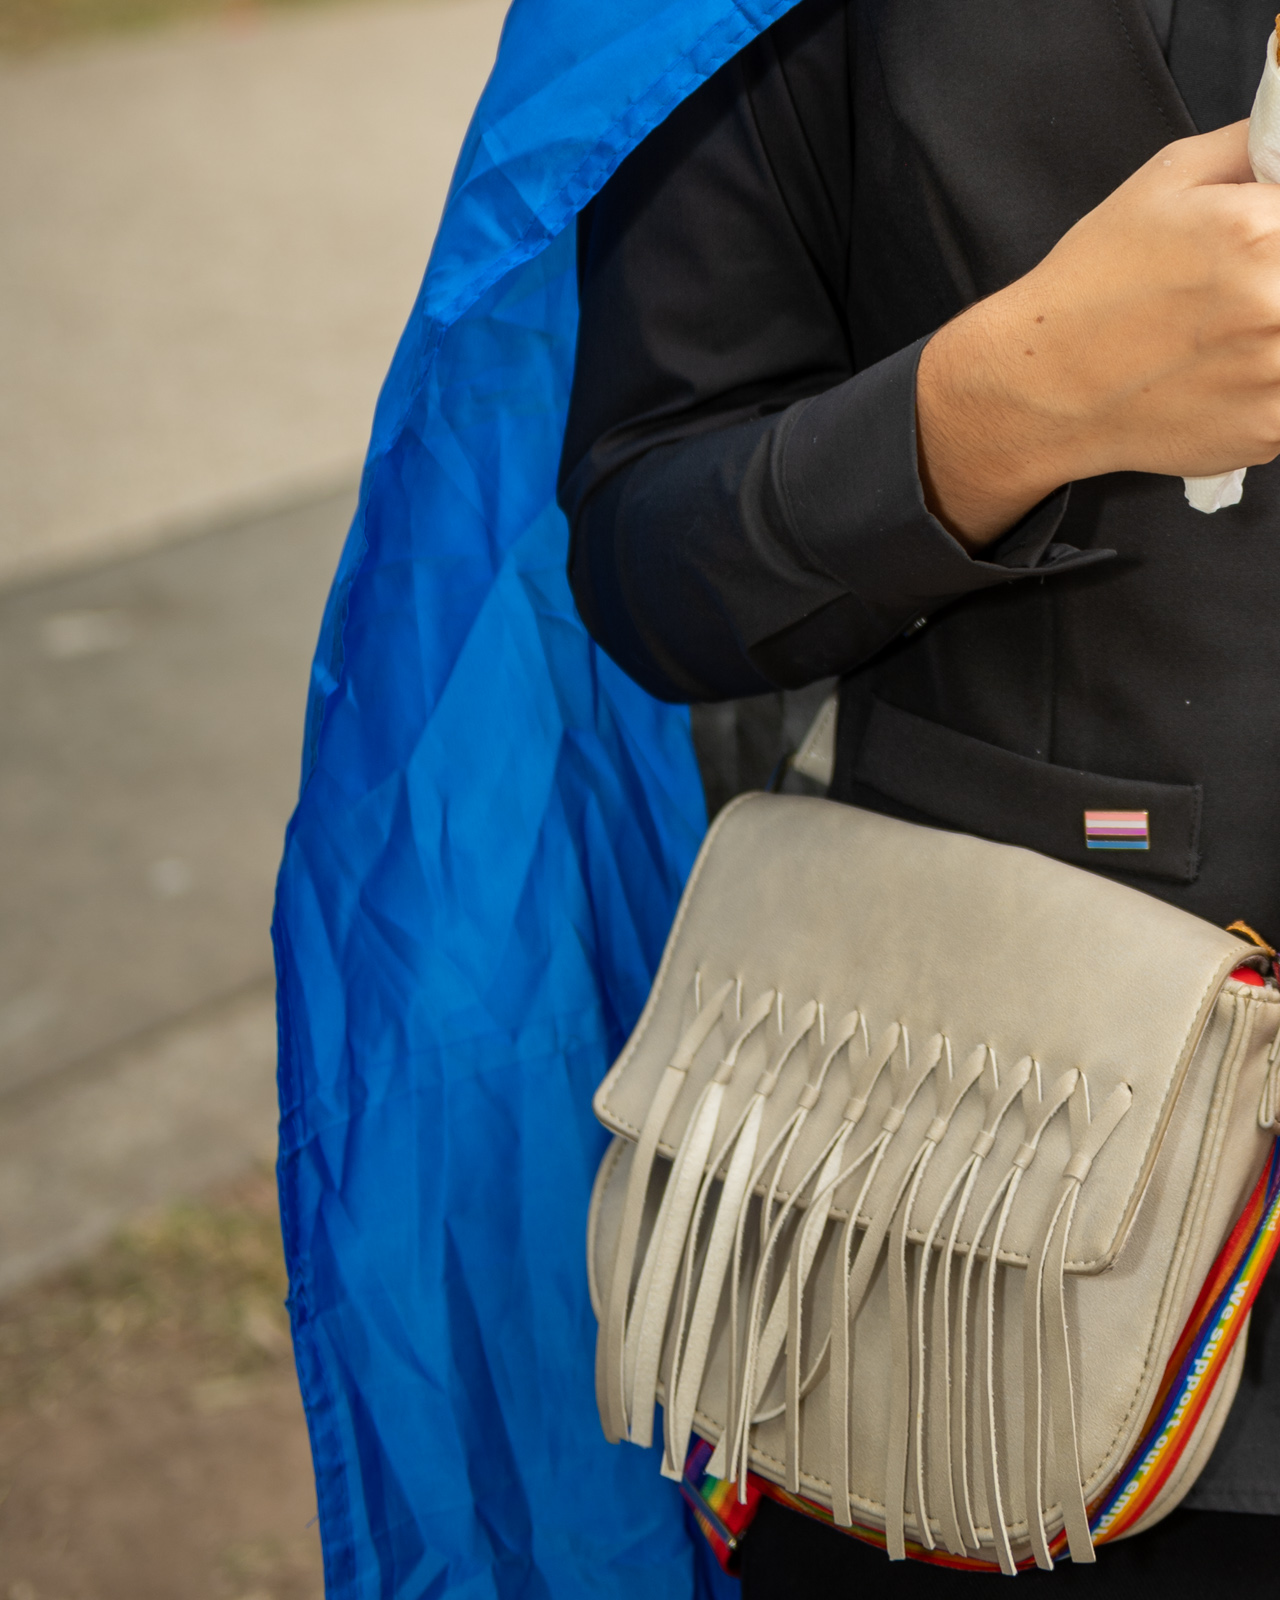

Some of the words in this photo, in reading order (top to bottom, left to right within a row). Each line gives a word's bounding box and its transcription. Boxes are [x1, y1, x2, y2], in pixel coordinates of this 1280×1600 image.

[1220, 1280, 1250, 1321] We
[1165, 1326, 1224, 1429] support
[1138, 1435, 1169, 1476] our
